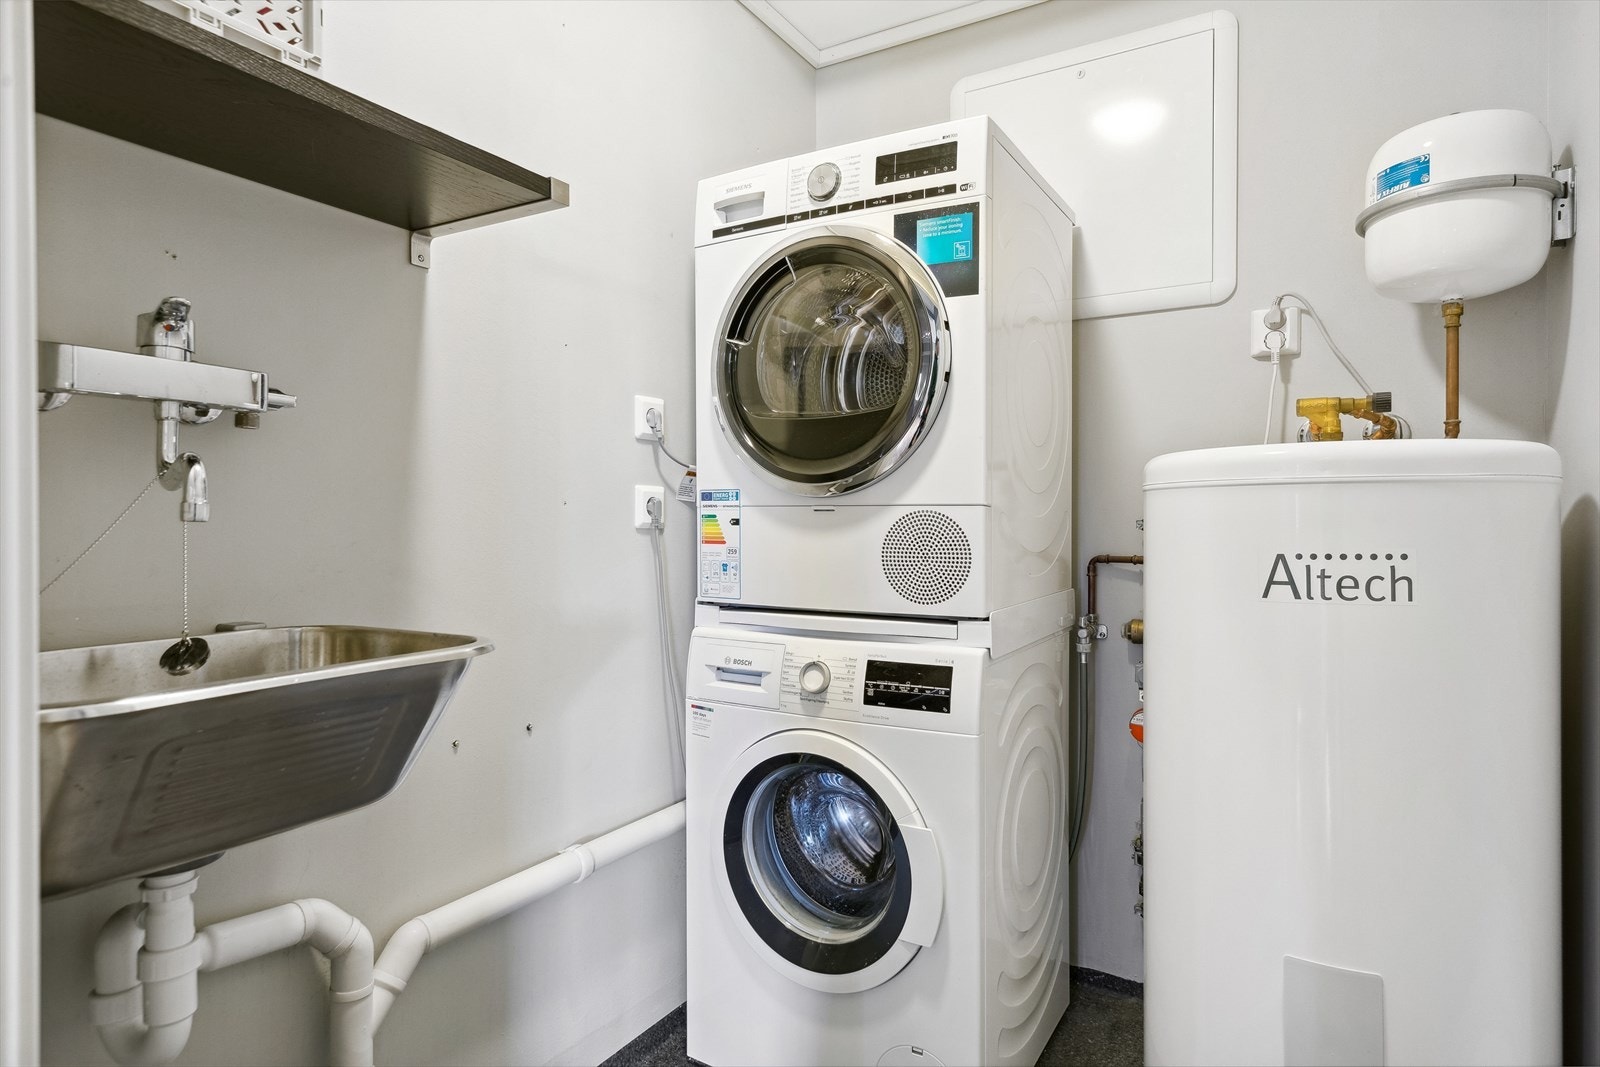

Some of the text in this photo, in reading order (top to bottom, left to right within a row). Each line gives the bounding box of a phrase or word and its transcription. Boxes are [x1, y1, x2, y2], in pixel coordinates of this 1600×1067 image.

[726, 183, 752, 193] SIEMENS
[1382, 181, 1410, 197] AIRFIX
[1261, 553, 1413, 602] Altech
[733, 658, 752, 666] BOSCH
